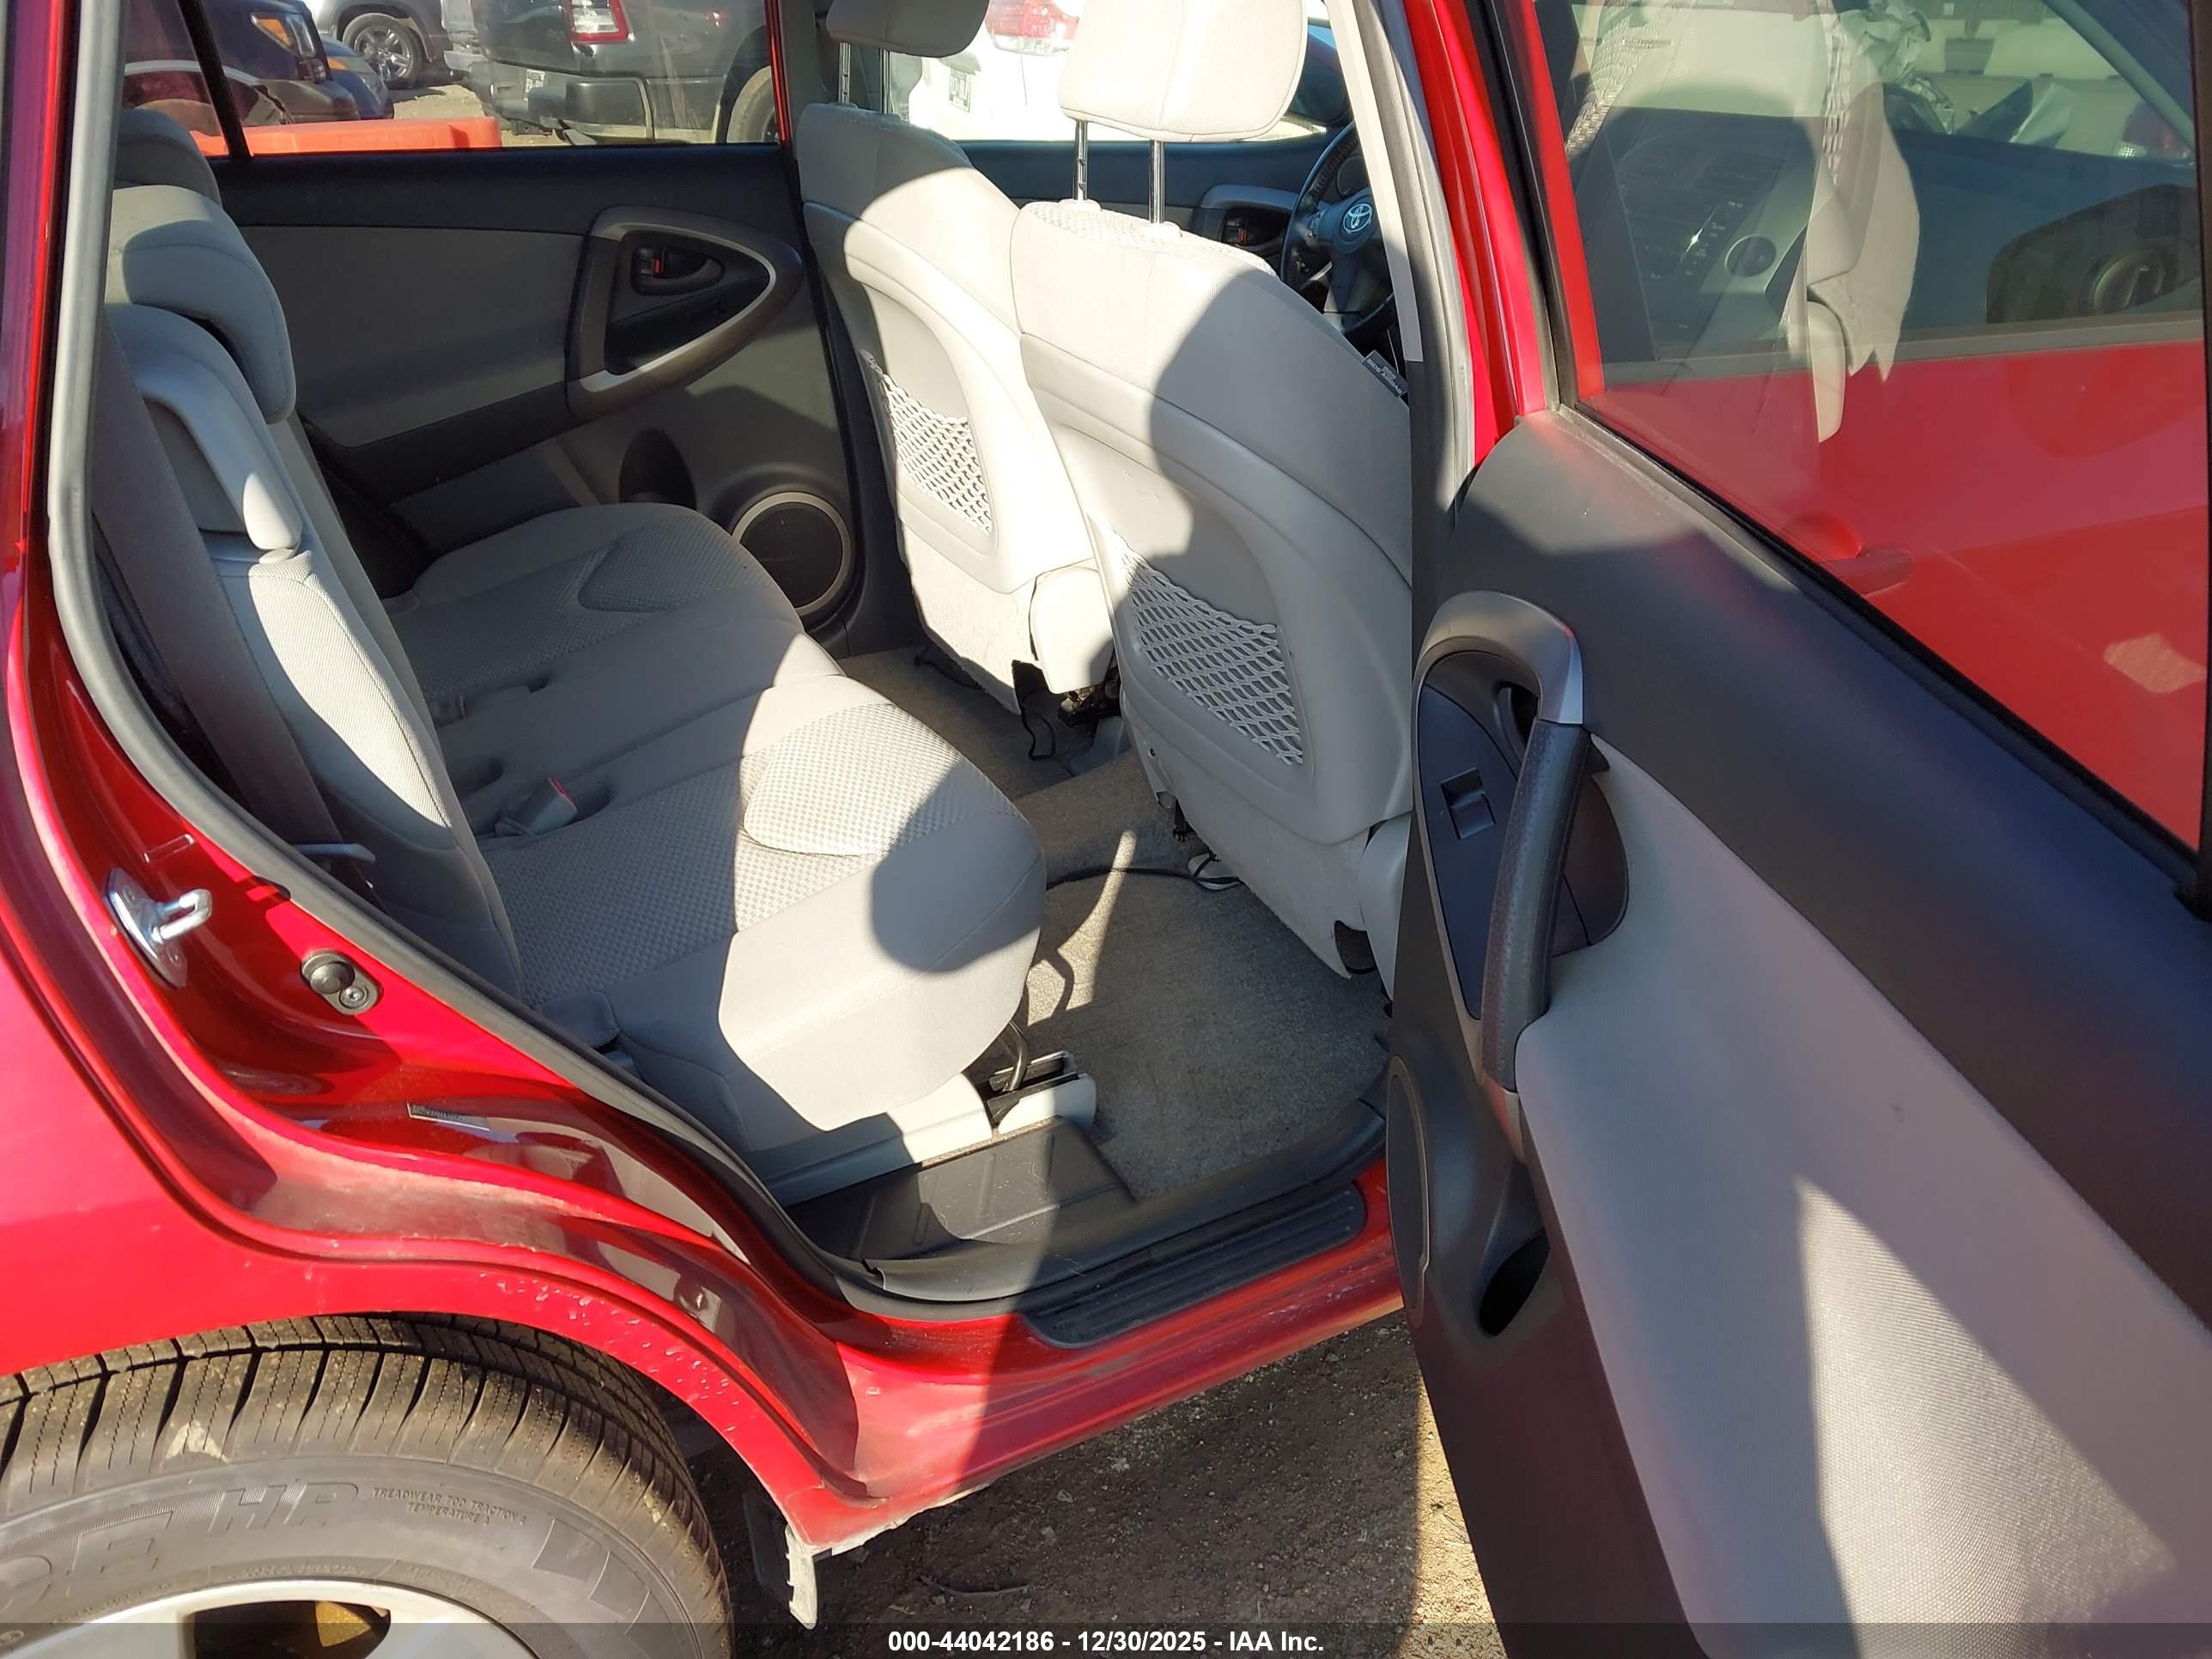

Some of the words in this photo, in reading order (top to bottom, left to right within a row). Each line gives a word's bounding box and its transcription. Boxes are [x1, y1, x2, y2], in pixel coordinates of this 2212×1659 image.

[372, 1486, 442, 1505] TREADWEAR
[470, 1499, 519, 1522] TRACTION
[407, 1502, 482, 1524] TEMPERATURE
